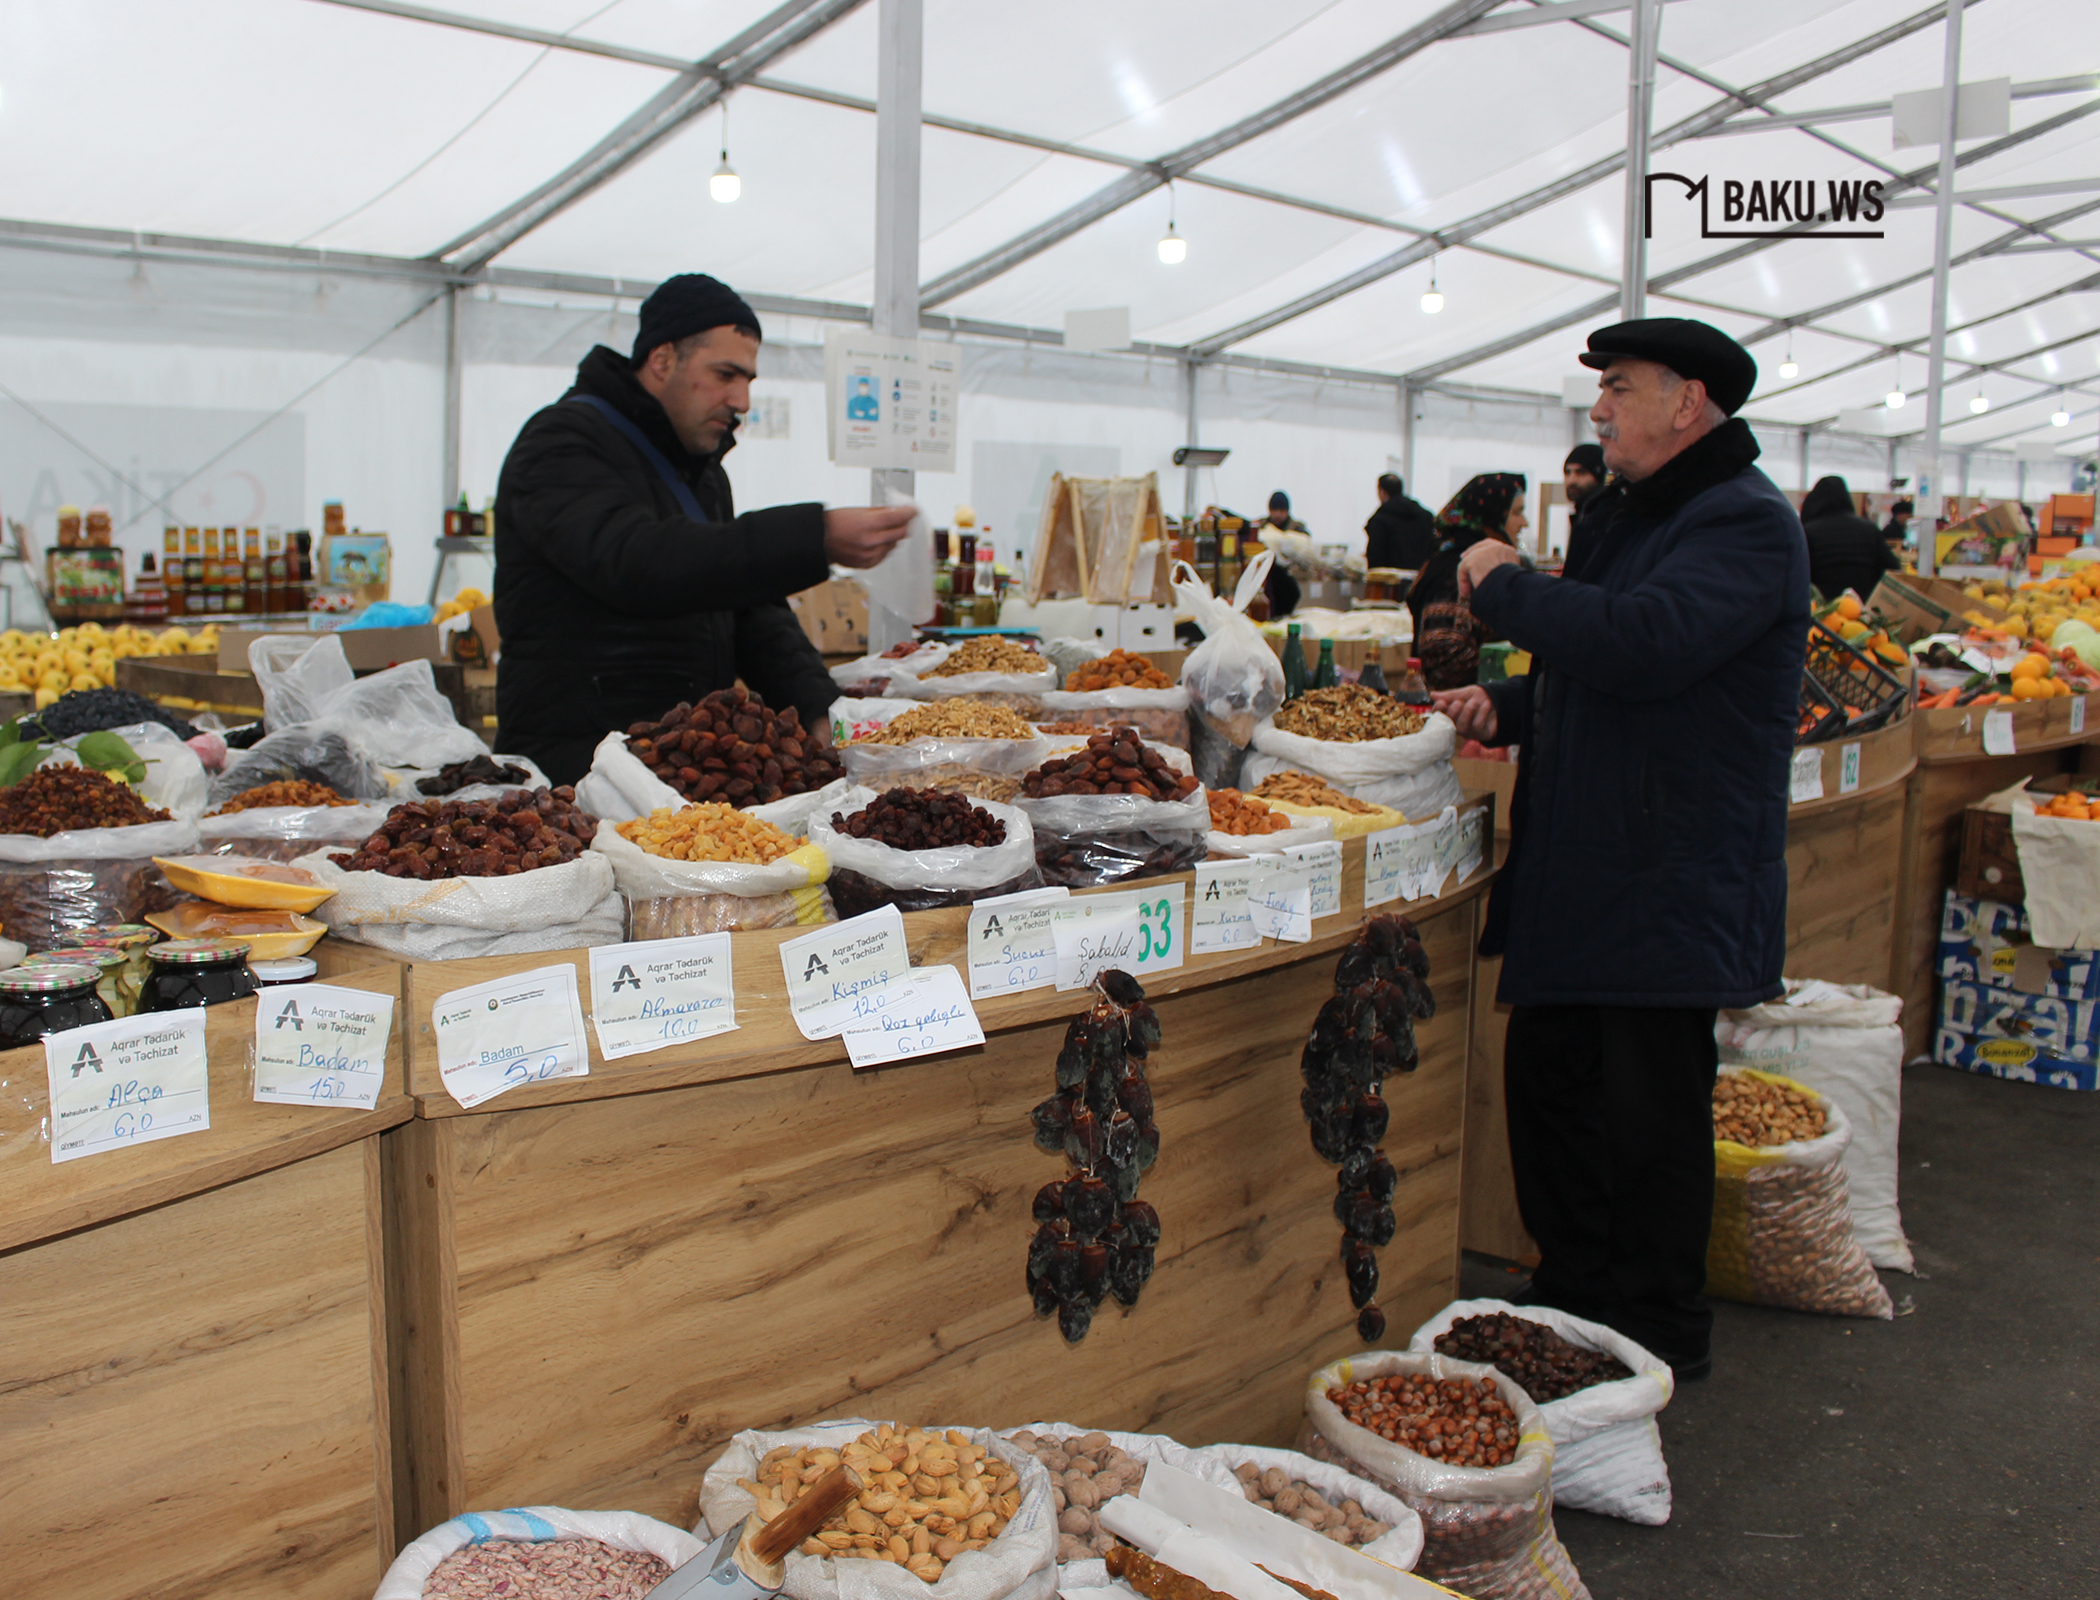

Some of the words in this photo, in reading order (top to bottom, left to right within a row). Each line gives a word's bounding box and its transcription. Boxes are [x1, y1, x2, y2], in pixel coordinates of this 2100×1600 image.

[1845, 752, 1857, 785] 62
[832, 941, 856, 958] Aqrar
[856, 929, 889, 949] Tədarük
[840, 956, 851, 966] və
[851, 942, 885, 961] Təchizat
[647, 961, 674, 975] Aqrar
[676, 955, 714, 970] Tədarük
[655, 975, 667, 984] və
[668, 967, 708, 982] Təchizat
[1008, 965, 1038, 987] 6,0
[832, 969, 890, 1003] Kişmiş
[311, 1006, 338, 1019] Aqrar
[339, 1009, 377, 1024] Tədarük
[852, 995, 887, 1019] 12,0
[316, 1022, 328, 1031] və
[330, 1021, 367, 1036] Təchizat
[111, 1038, 142, 1054] Aqrar
[144, 1029, 186, 1047] Tədarük
[119, 1054, 132, 1065] və
[134, 1045, 179, 1062] Təchizat
[299, 1043, 369, 1073] Badam
[480, 1044, 524, 1064] Badam
[108, 1079, 164, 1109] Alça
[309, 1077, 346, 1100] 15,0
[114, 1111, 154, 1139] 6,0
